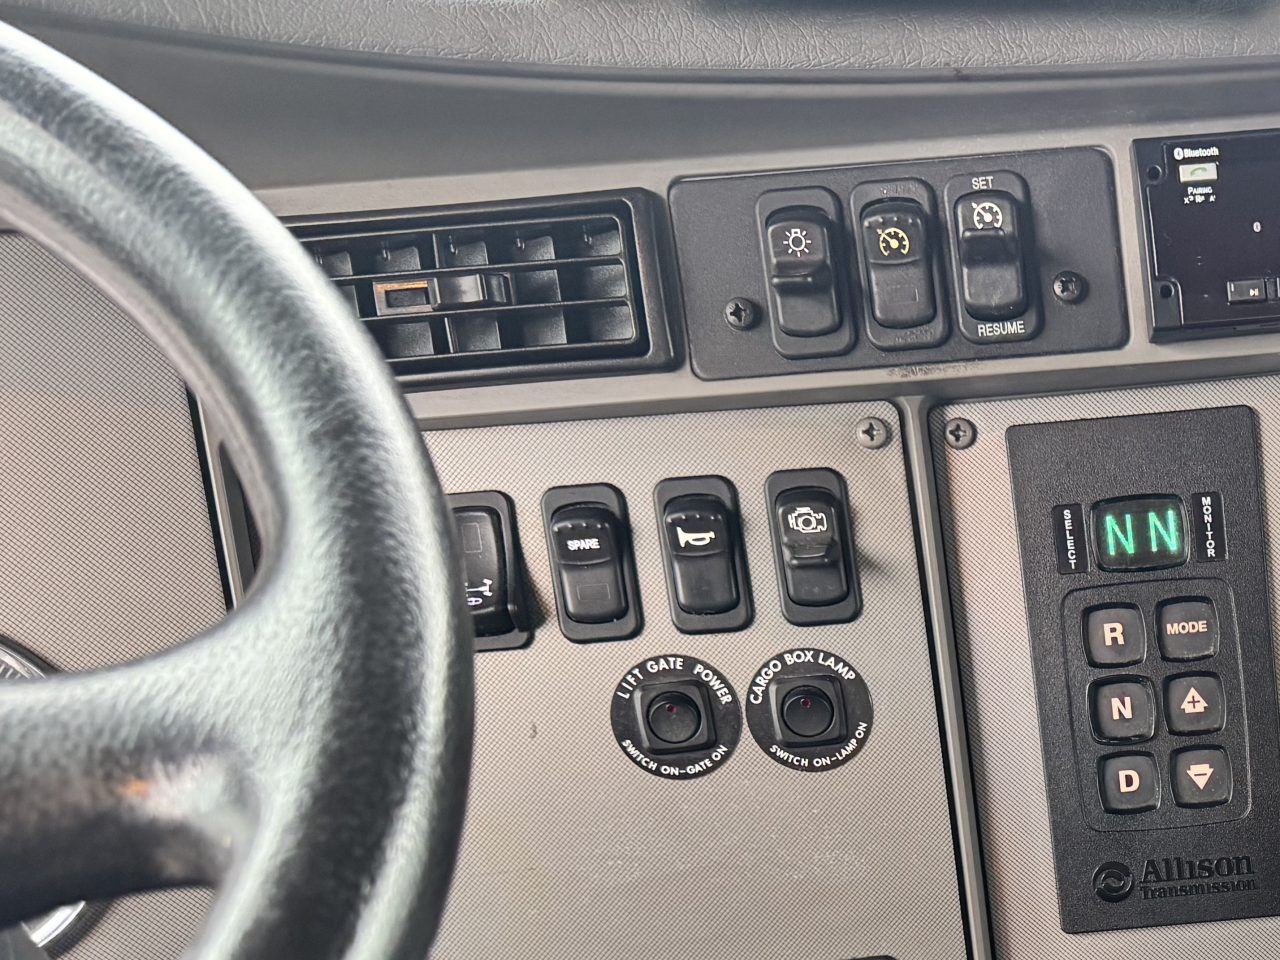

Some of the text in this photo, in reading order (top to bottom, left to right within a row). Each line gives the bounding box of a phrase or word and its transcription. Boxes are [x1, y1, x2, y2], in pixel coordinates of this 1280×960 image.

[1184, 146, 1219, 158] Bluetooth
[972, 176, 993, 189] SET
[978, 321, 1024, 336] RESUME
[1063, 509, 1076, 569] SELECT
[1106, 509, 1178, 556] N N
[1202, 496, 1215, 558] MONITOR
[567, 538, 600, 550] SPARE
[1103, 622, 1125, 646] R
[1166, 620, 1208, 635] MODE
[616, 657, 732, 704] LIFT GATE POWER
[750, 651, 856, 704] CARGO BOX LAMP
[1111, 697, 1133, 720] N
[622, 740, 658, 771] SWITCH
[711, 745, 728, 760] ON
[770, 745, 808, 767] SWITCH
[855, 722, 868, 739] ON
[1118, 769, 1140, 793] D
[1140, 855, 1255, 884] Allison
[1140, 877, 1258, 899] Transmission
